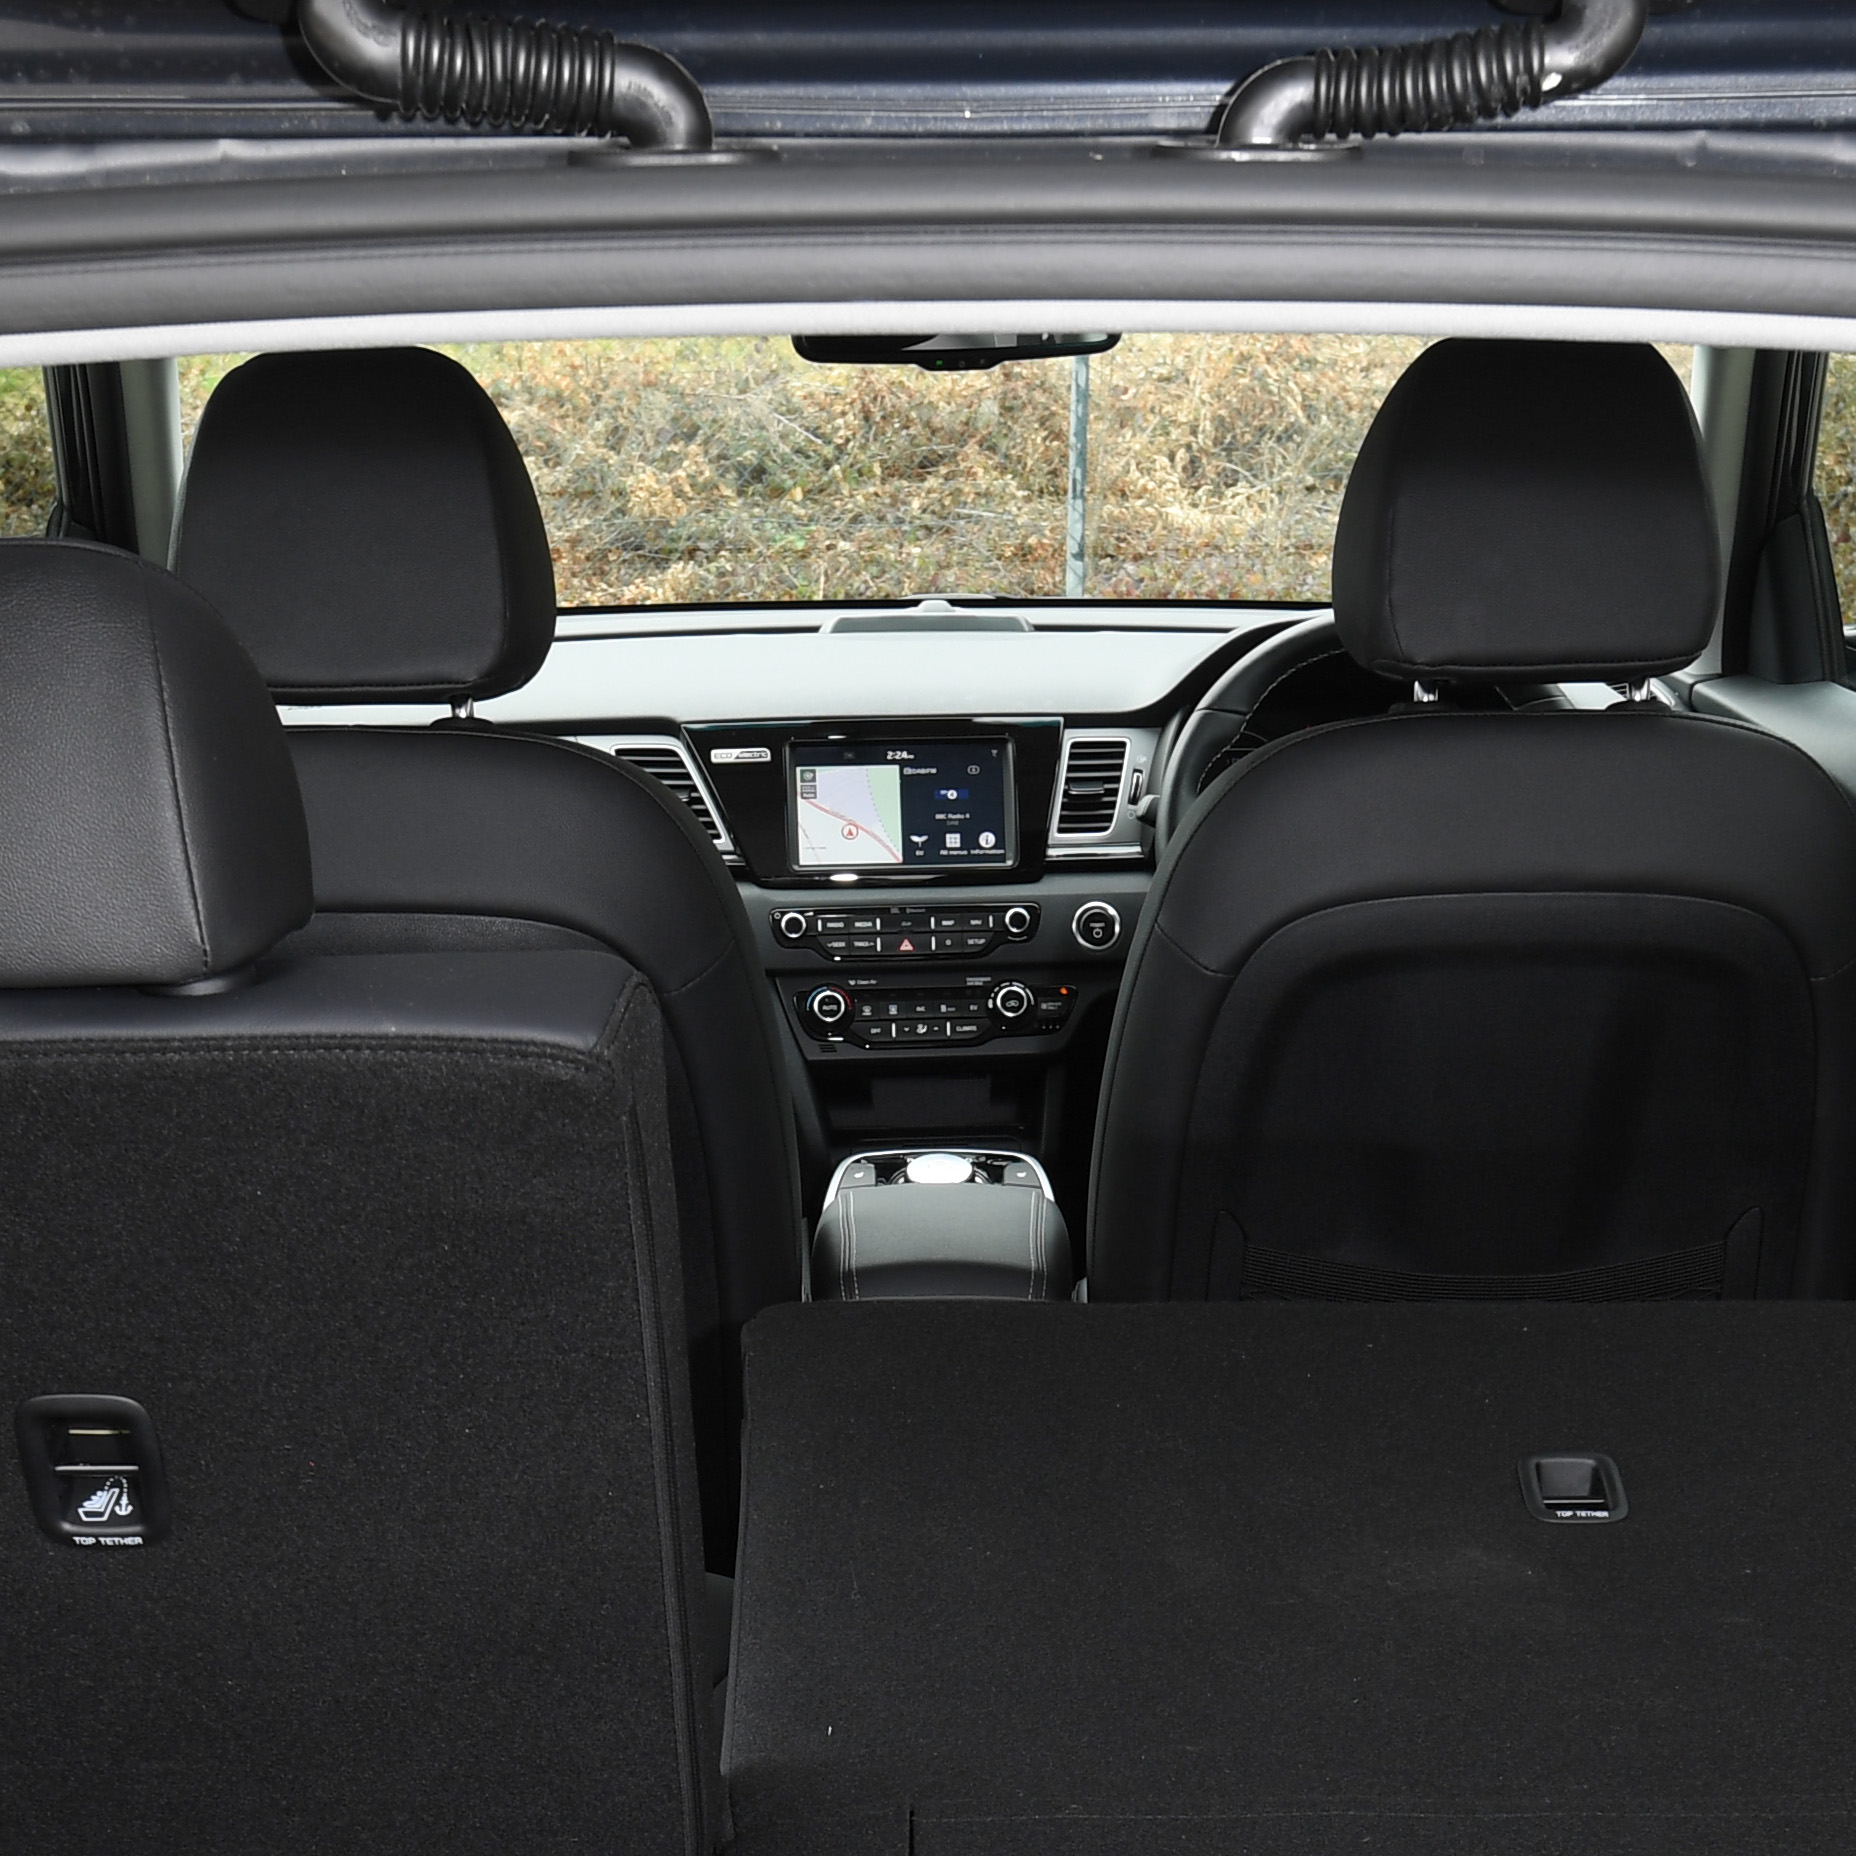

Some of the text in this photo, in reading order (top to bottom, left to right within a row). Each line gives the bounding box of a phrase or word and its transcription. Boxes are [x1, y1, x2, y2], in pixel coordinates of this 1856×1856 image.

[1554, 1510, 1610, 1518] TOP TETHER
[71, 1536, 144, 1546] TOP TETHER
